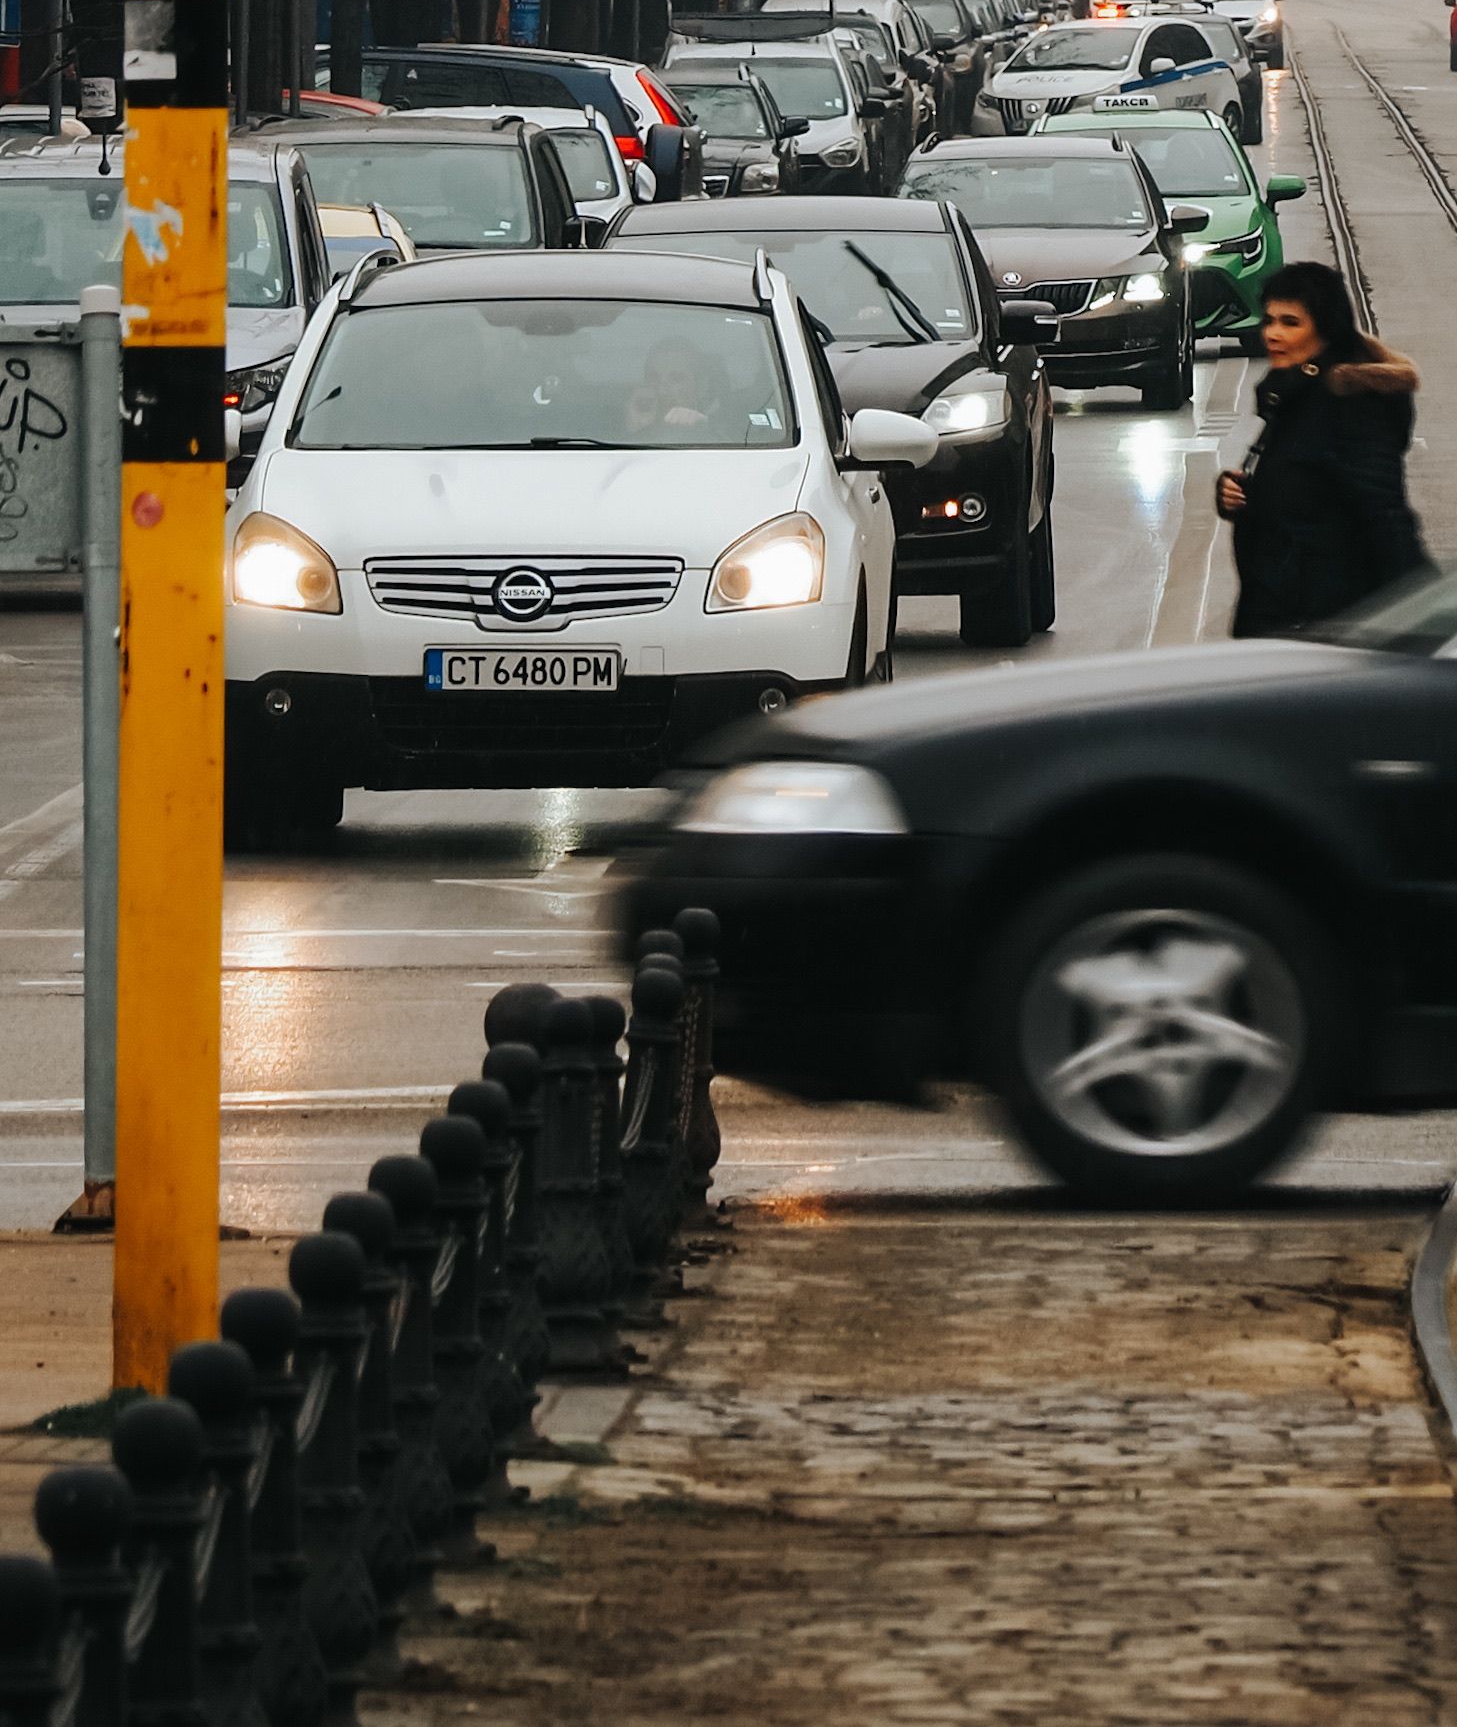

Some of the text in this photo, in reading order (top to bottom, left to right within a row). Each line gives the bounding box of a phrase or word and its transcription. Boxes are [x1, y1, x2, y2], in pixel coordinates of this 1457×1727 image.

[1016, 75, 1075, 84] POLICE
[1103, 98, 1149, 108] ТАКСИ
[500, 589, 545, 597] NISSAN
[448, 656, 611, 686] CT 6480 PM
